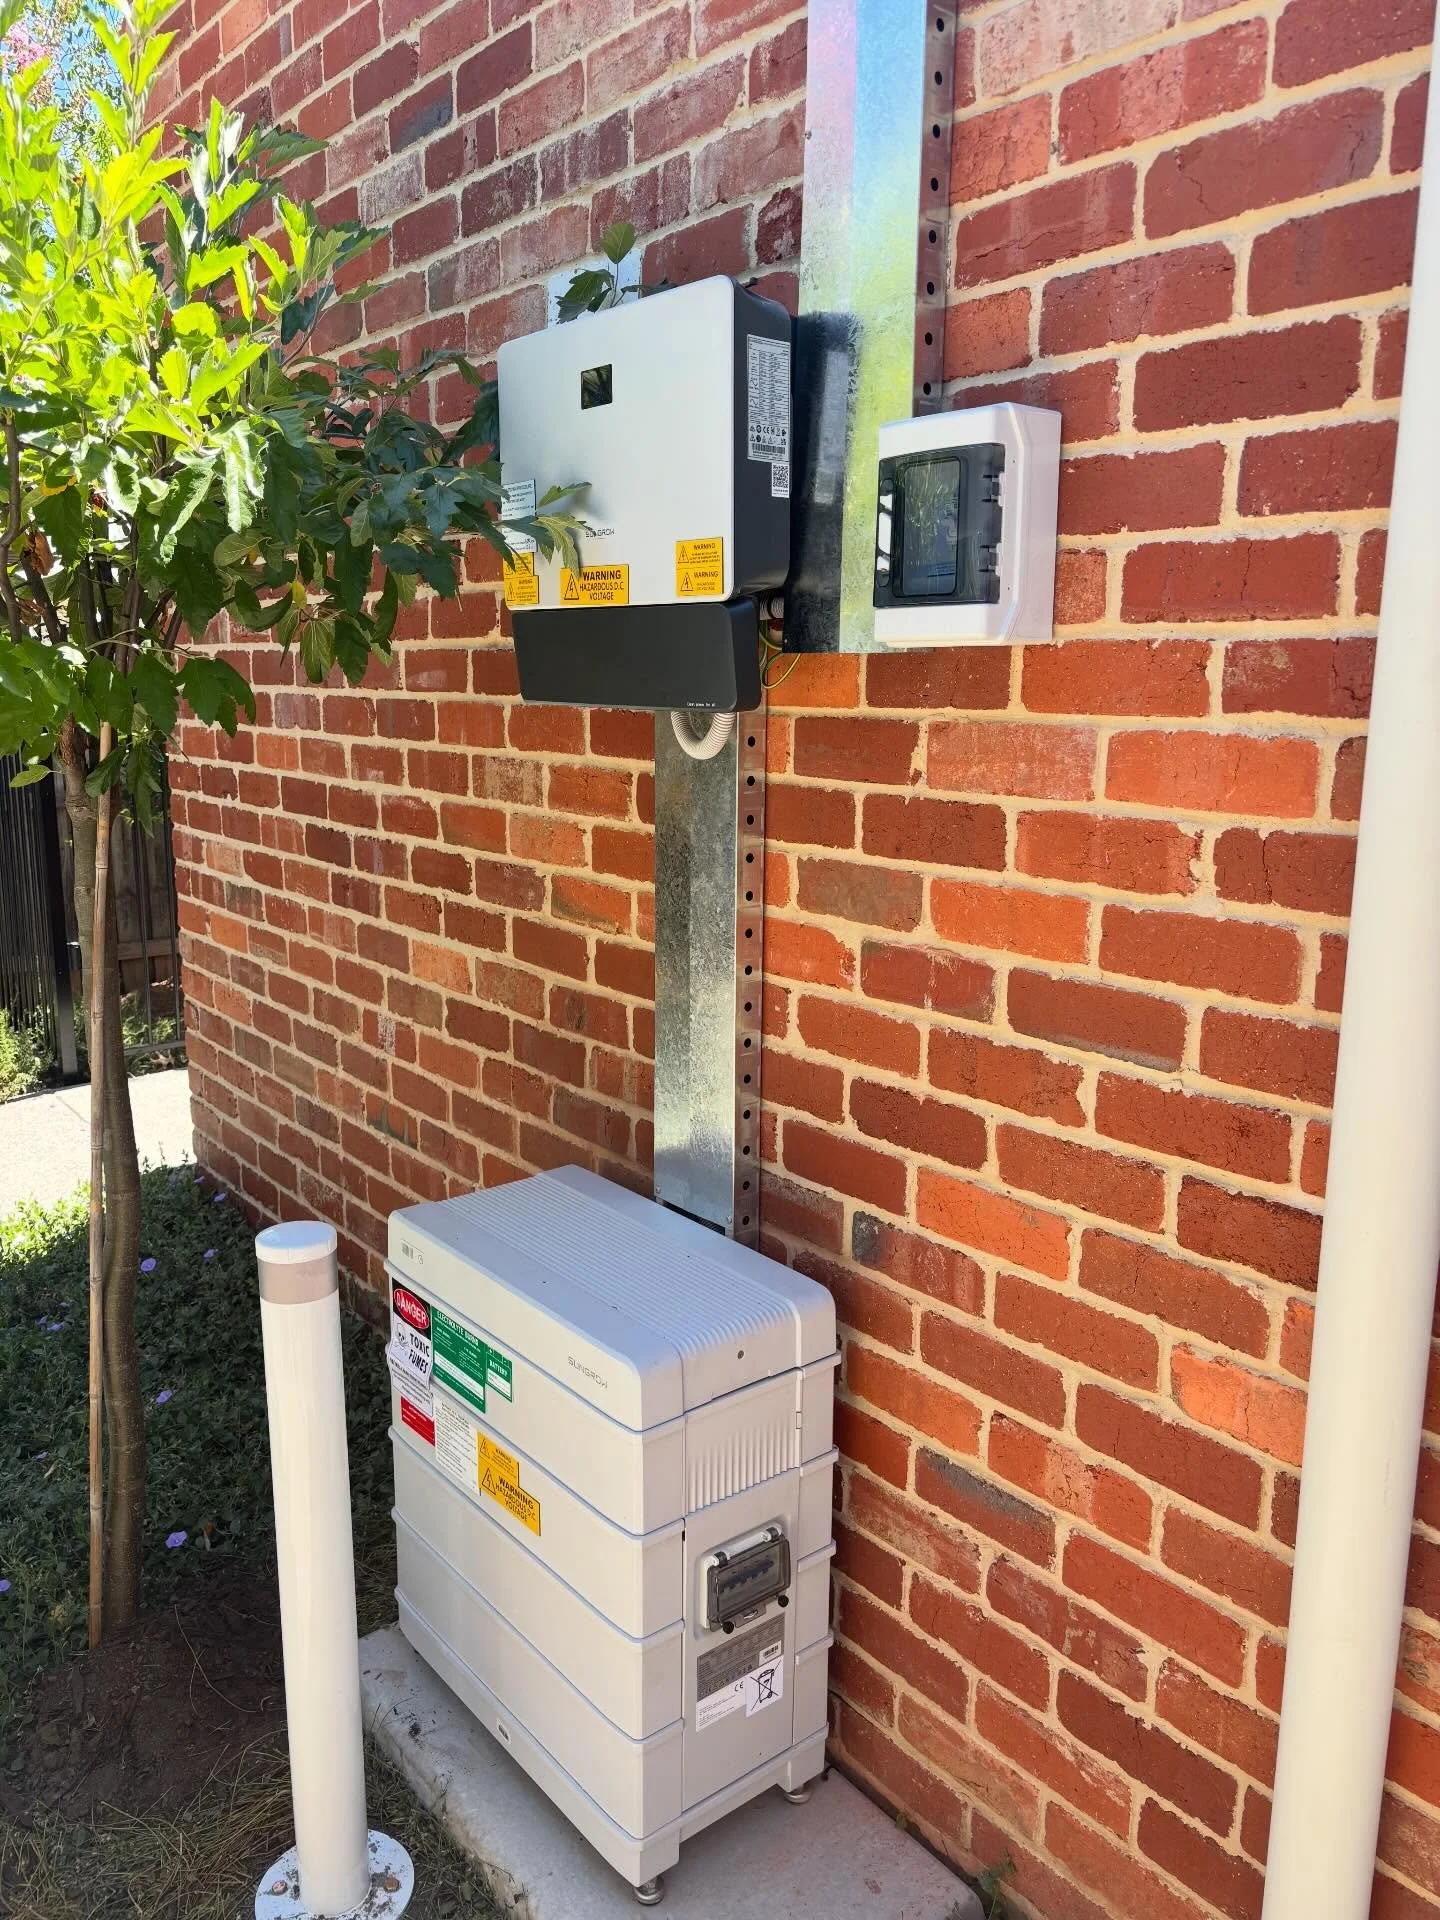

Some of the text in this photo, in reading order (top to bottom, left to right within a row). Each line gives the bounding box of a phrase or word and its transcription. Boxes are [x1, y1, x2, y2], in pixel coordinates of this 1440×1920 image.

[586, 529, 614, 538] SUGROW
[583, 569, 621, 581] WARNING
[579, 582, 614, 592] HAZARDOUS
[589, 591, 614, 601] VOLTAGE
[396, 1291, 428, 1326] DANGER
[437, 1311, 464, 1335] ELECTROLYTE
[409, 1333, 430, 1357] TOXIC
[408, 1349, 429, 1374] FUMES
[489, 1359, 508, 1377] BATTERY
[499, 1475, 534, 1510] WARNING
[504, 1498, 527, 1521] VOLTAGE
